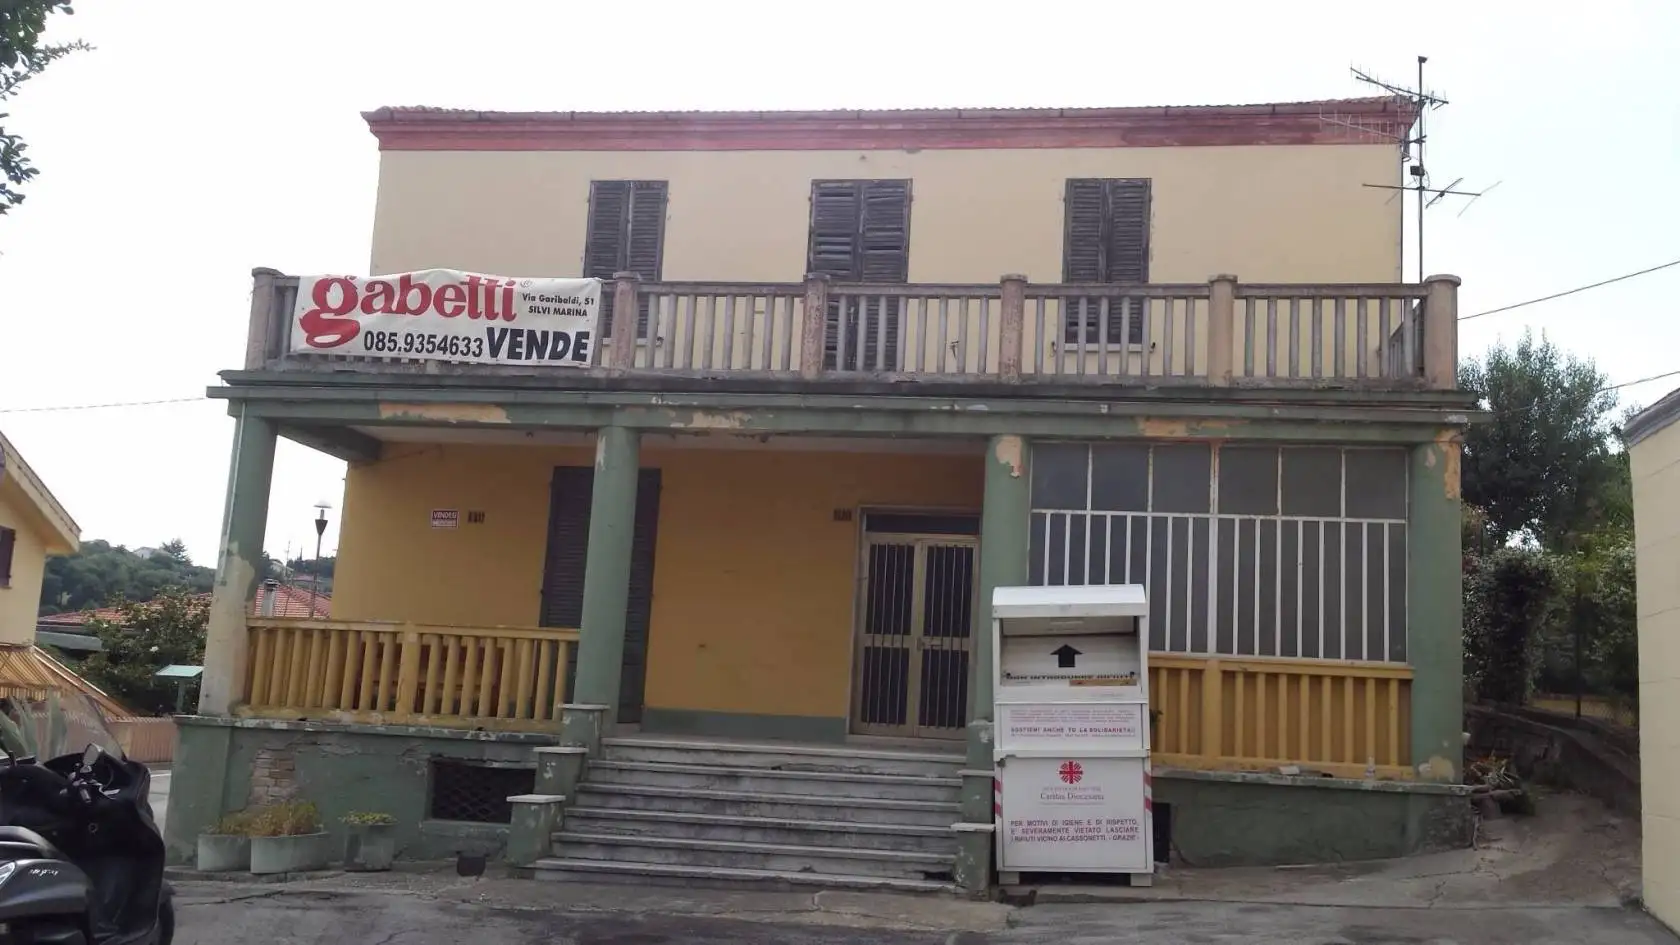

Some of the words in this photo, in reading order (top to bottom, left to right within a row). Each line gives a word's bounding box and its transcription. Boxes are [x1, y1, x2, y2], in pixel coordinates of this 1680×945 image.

[300, 274, 518, 348] gabetti
[522, 293, 537, 303] Via
[538, 294, 583, 306] Garibaldi,
[584, 297, 595, 305] 51
[528, 305, 551, 315] SILVI
[552, 308, 588, 317] MARINA
[363, 330, 483, 358] 085.9354633
[486, 327, 590, 362] VENDE
